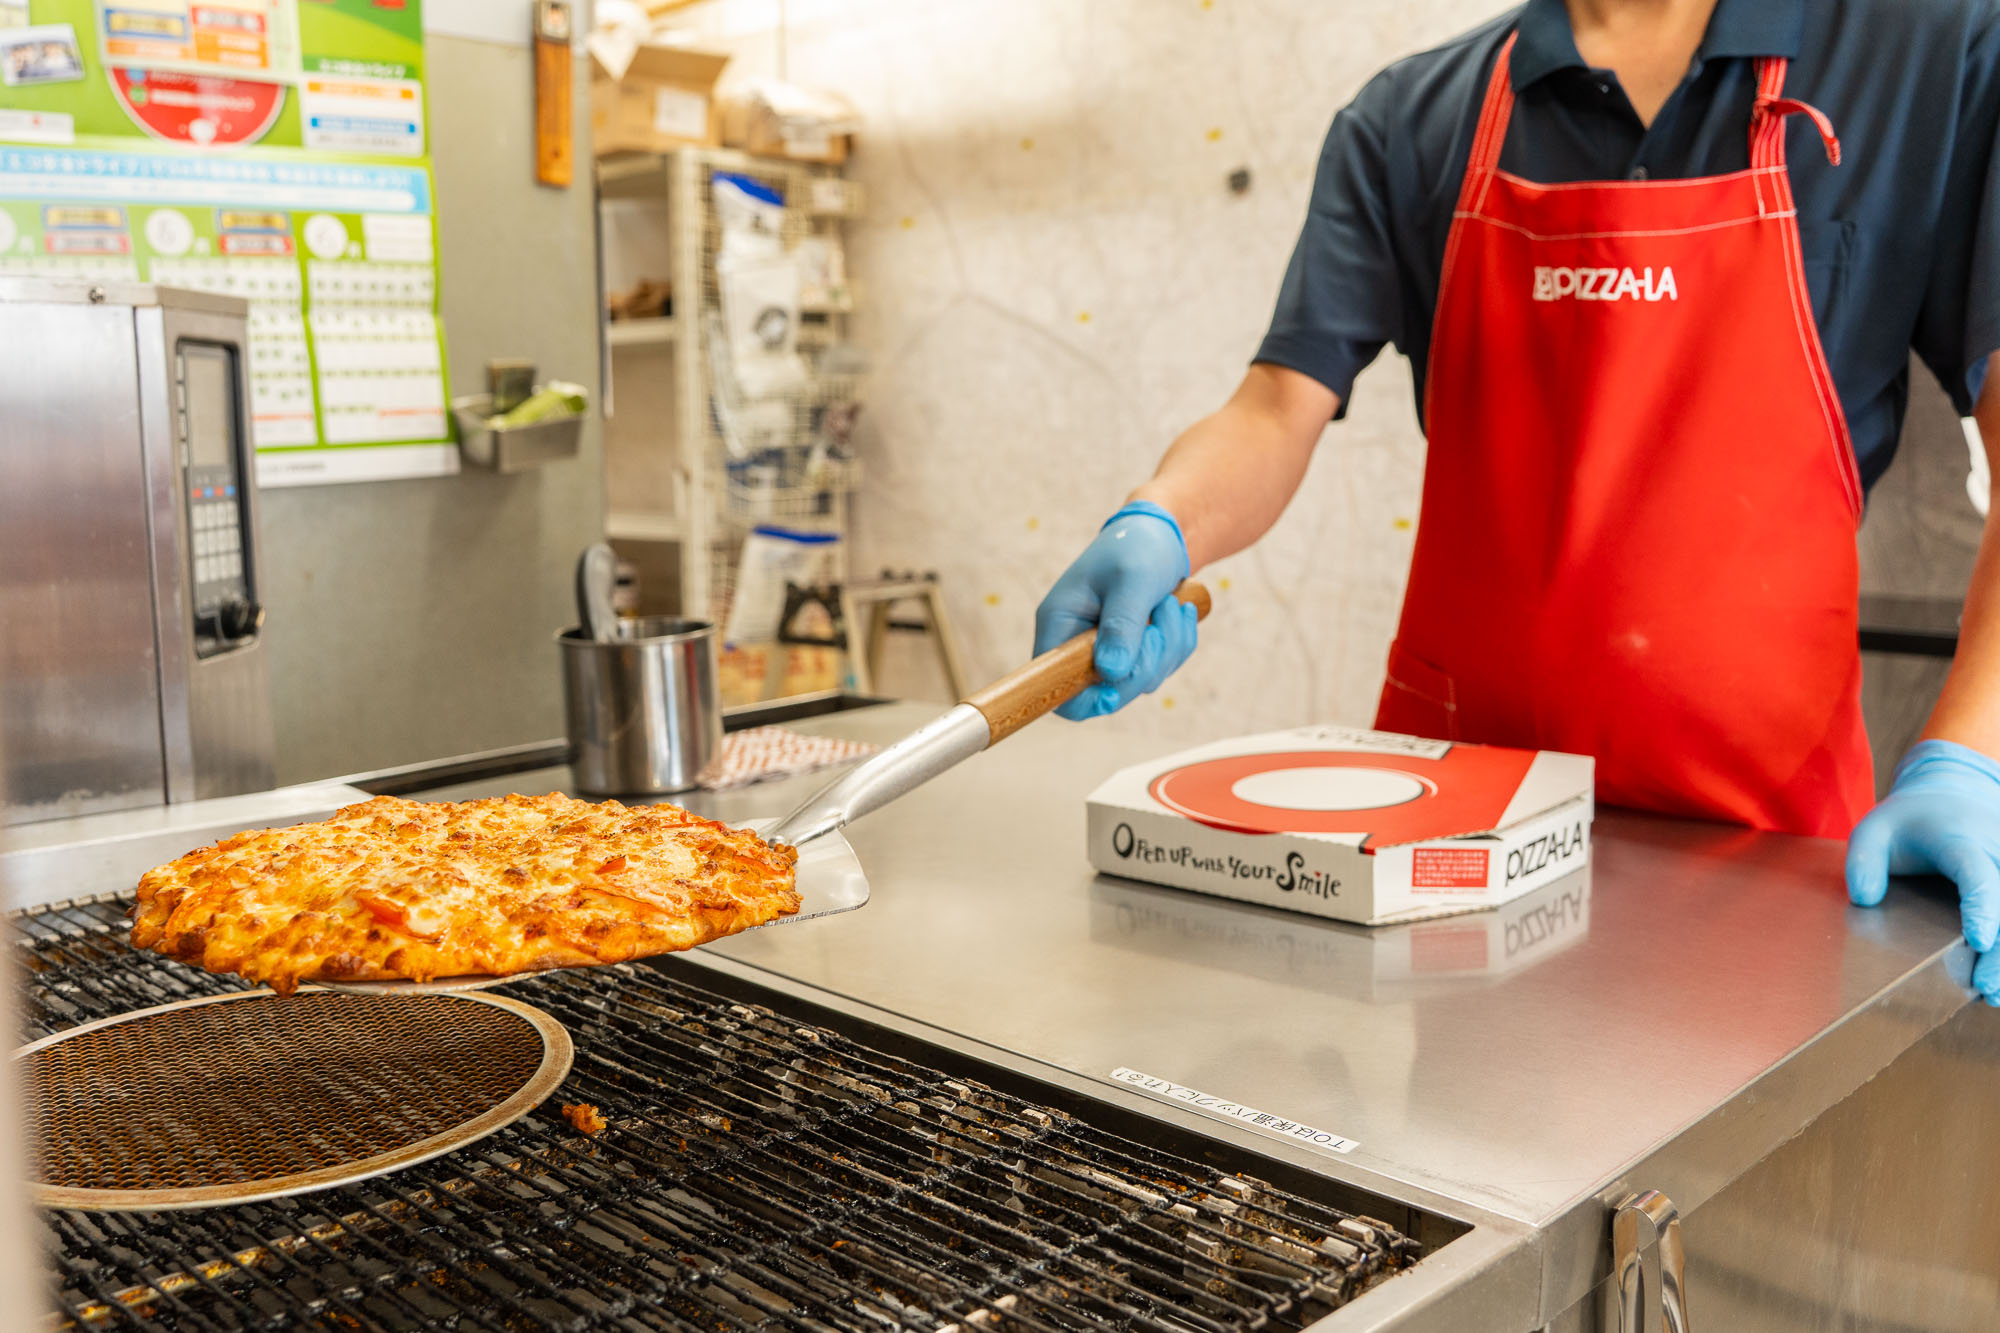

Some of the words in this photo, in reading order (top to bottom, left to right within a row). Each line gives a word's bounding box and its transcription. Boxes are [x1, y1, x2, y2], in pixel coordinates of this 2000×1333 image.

[1551, 266, 1678, 301] PIZZA-LA
[1276, 851, 1341, 899] Smile
[1505, 821, 1584, 887] PIZZA-LA
